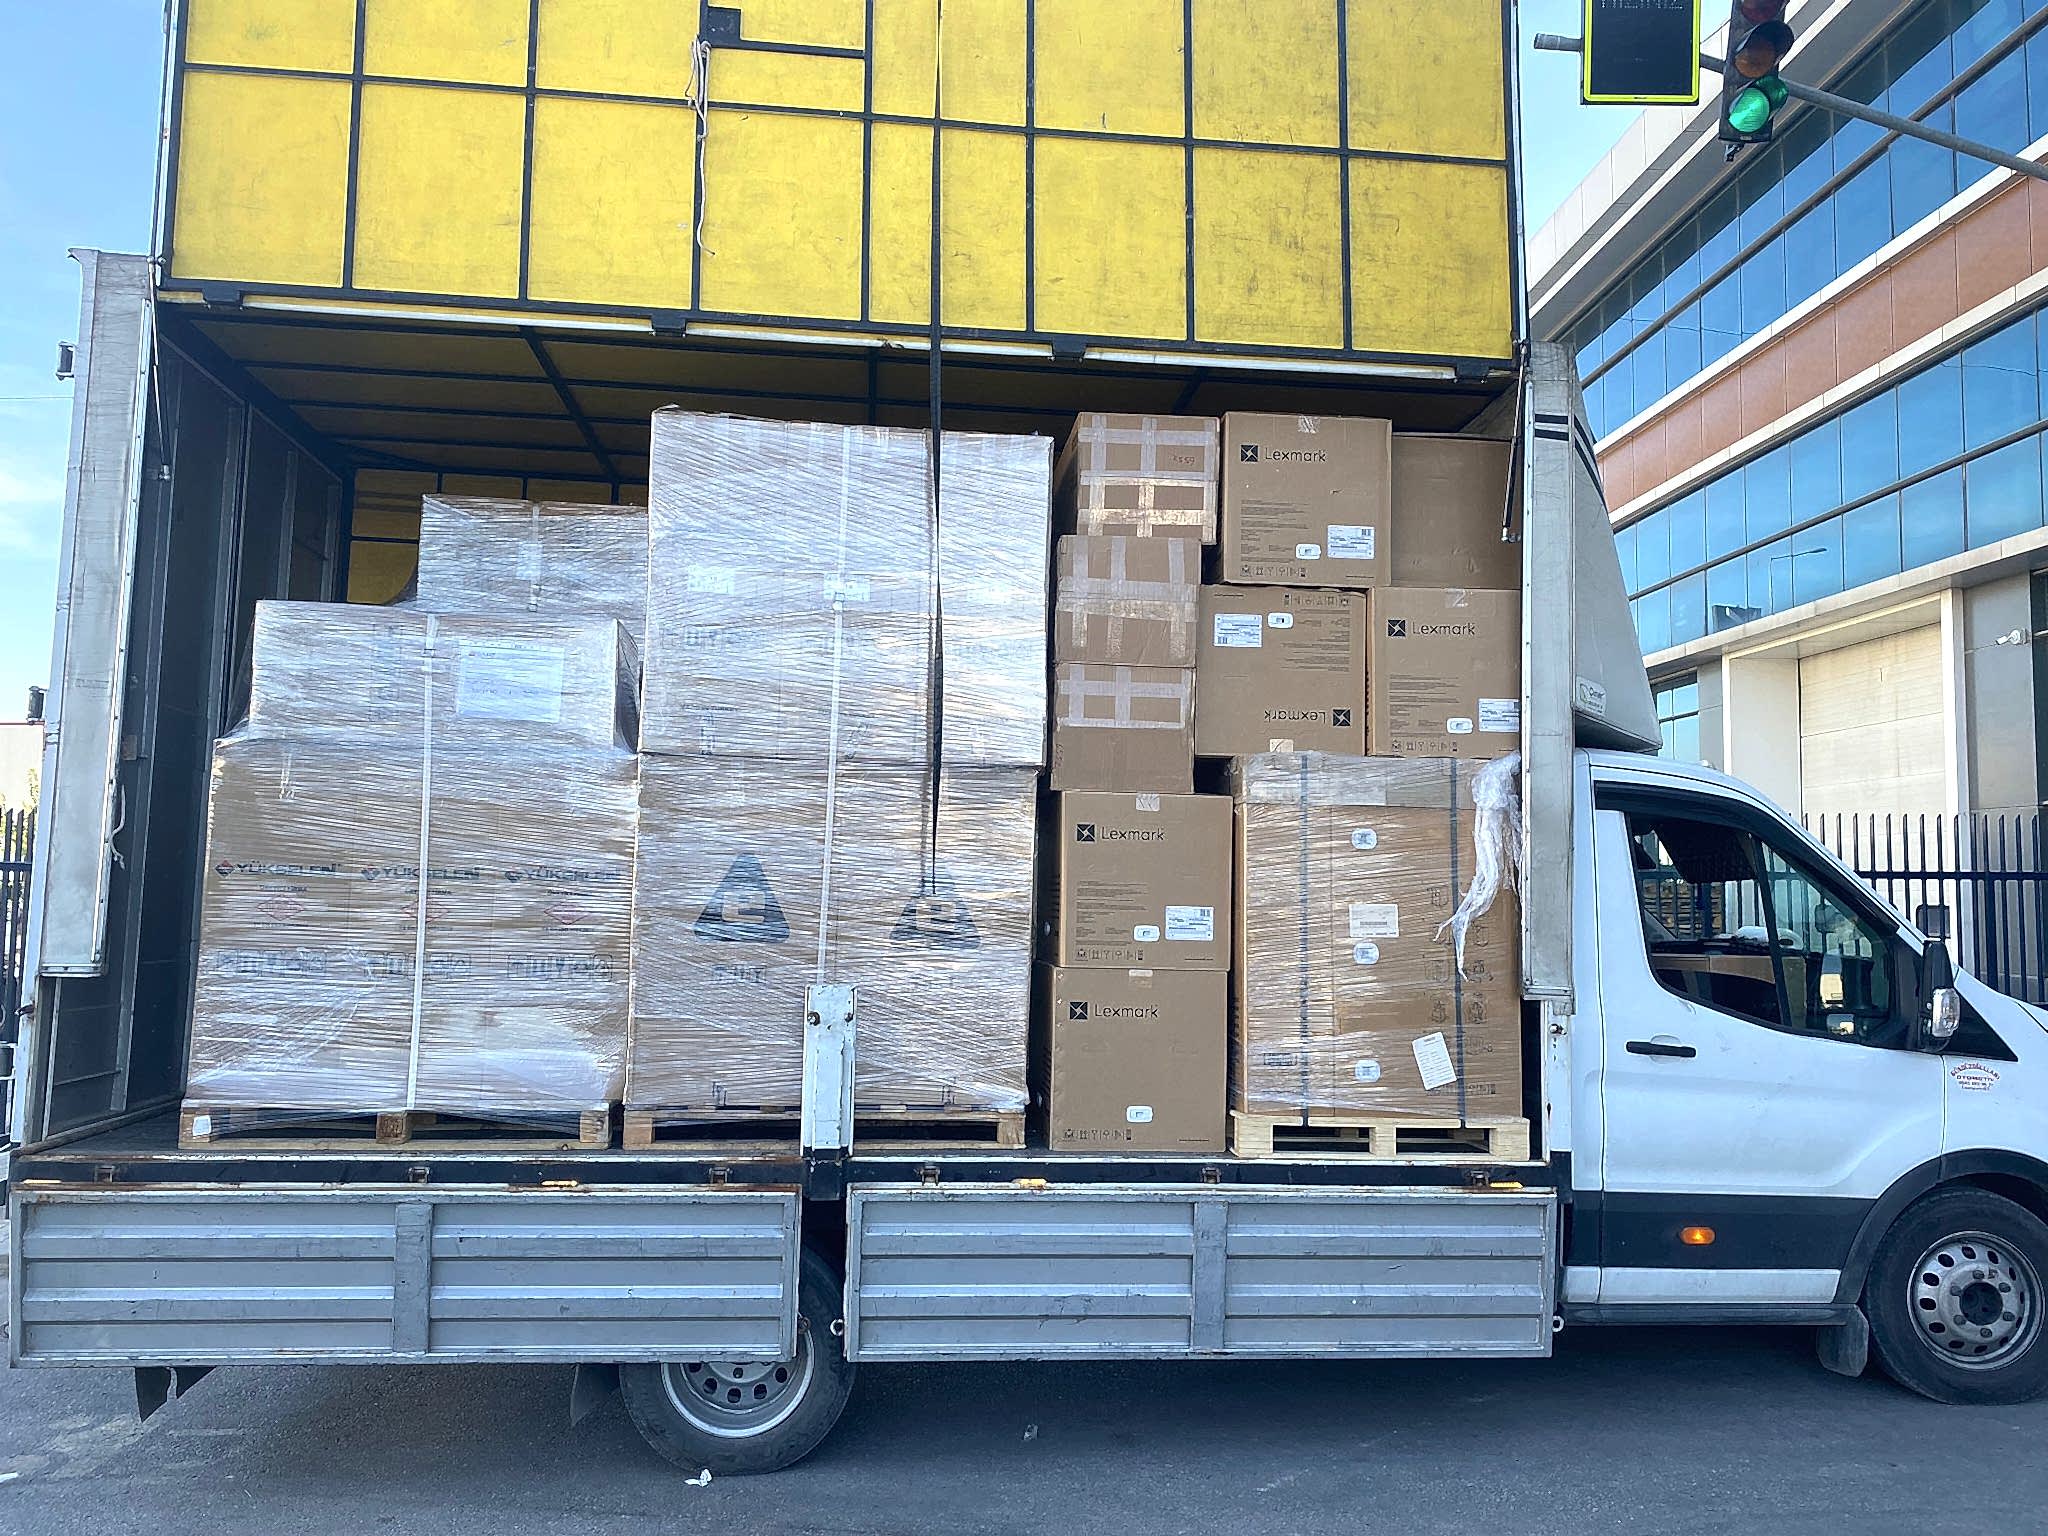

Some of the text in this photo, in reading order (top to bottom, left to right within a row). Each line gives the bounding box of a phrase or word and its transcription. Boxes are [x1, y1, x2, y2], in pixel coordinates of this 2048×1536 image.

[1265, 447, 1327, 462] Lexmark
[1412, 621, 1476, 636] Lexmark
[1264, 709, 1326, 724] Lexmark
[1101, 826, 1165, 842] Lexmark
[1094, 1003, 1159, 1018] Lexmark
